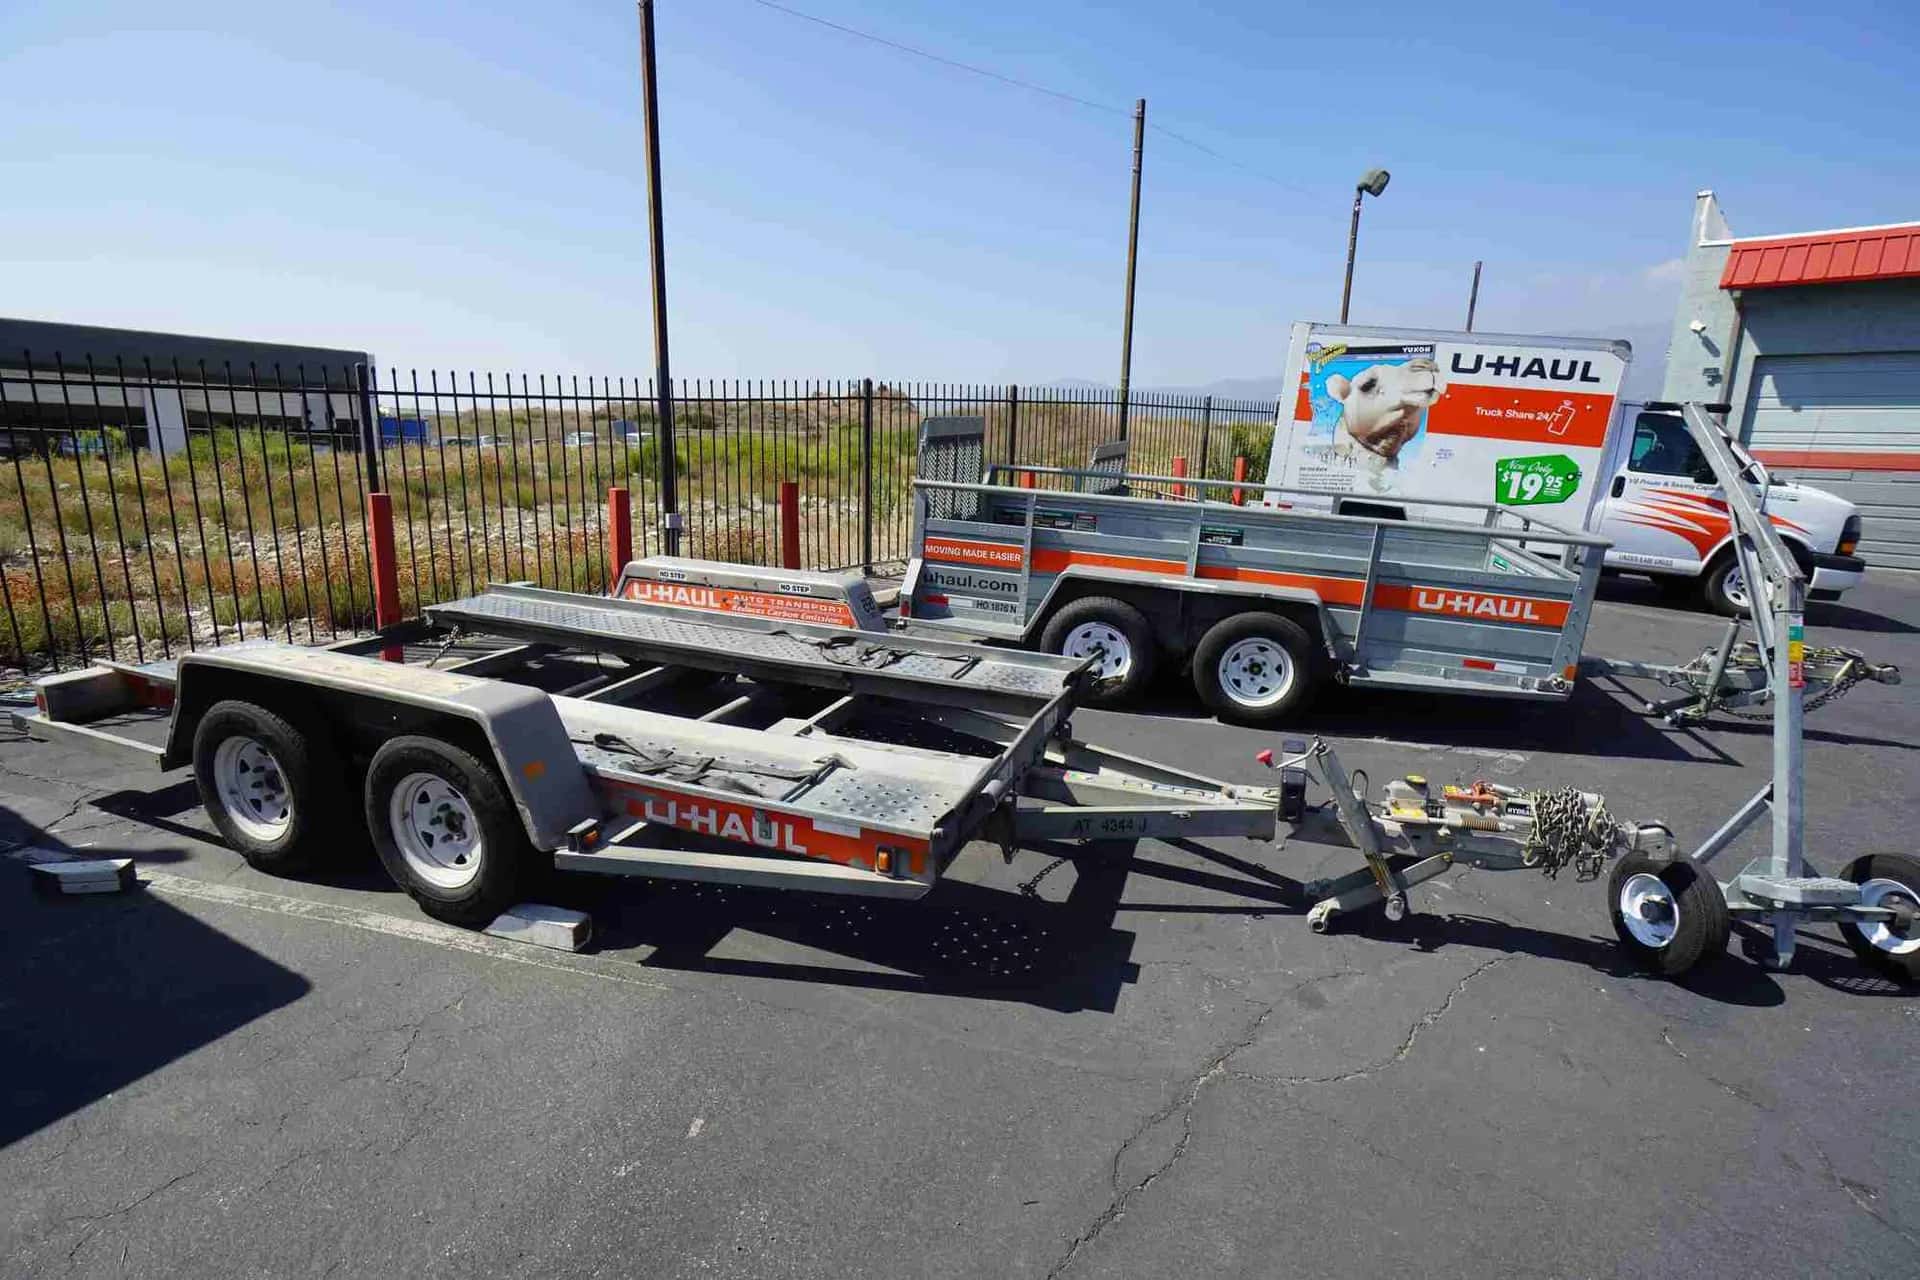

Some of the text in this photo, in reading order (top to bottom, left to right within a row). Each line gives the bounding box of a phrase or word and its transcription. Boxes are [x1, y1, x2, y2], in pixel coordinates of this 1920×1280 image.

[1402, 346, 1432, 354] YUKON
[1451, 352, 1601, 383] U-HAUL
[1475, 406, 1503, 417] Truck
[1505, 409, 1535, 420] Share
[925, 545, 1021, 562] MOVING MADE EASIER
[792, 585, 810, 593] STEP
[923, 572, 1018, 593] uhaul.com
[633, 582, 721, 608] U-HAUL
[733, 594, 764, 604] AUTO
[769, 599, 847, 613] TRANSPORT
[1417, 591, 1540, 621] U-HAUL
[645, 800, 808, 855] U-HAUL
